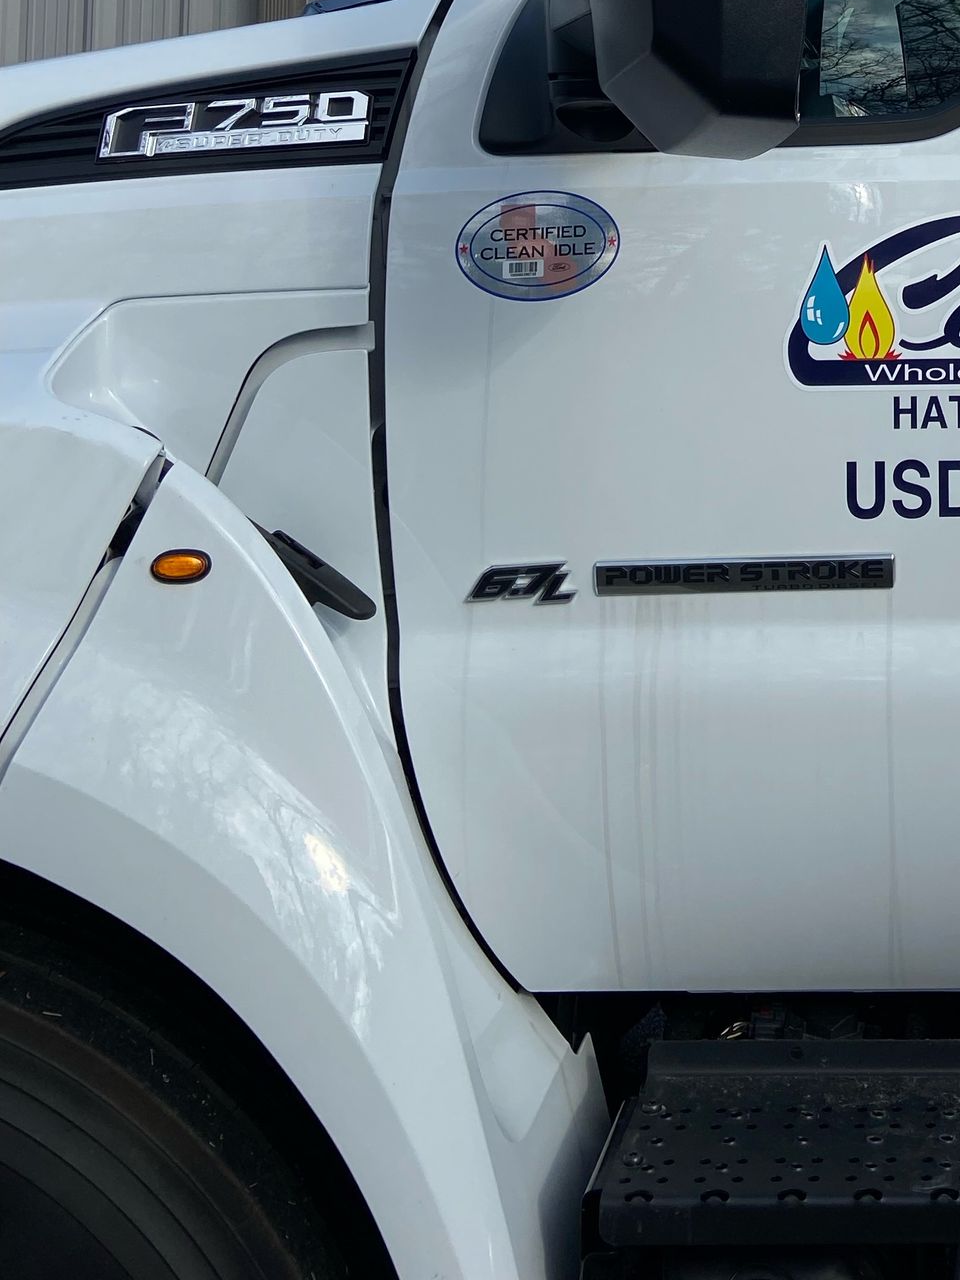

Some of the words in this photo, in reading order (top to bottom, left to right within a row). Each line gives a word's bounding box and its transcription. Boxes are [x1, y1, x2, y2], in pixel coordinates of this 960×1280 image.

[175, 132, 263, 150] SUPER
[277, 127, 343, 143] DUTY
[490, 225, 587, 242] CERTIFIED
[480, 245, 545, 260] CLEAN
[554, 242, 596, 257] IDLE
[463, 560, 580, 606] 6.7L
[605, 564, 730, 586] POWER
[740, 559, 885, 581] STROKE
